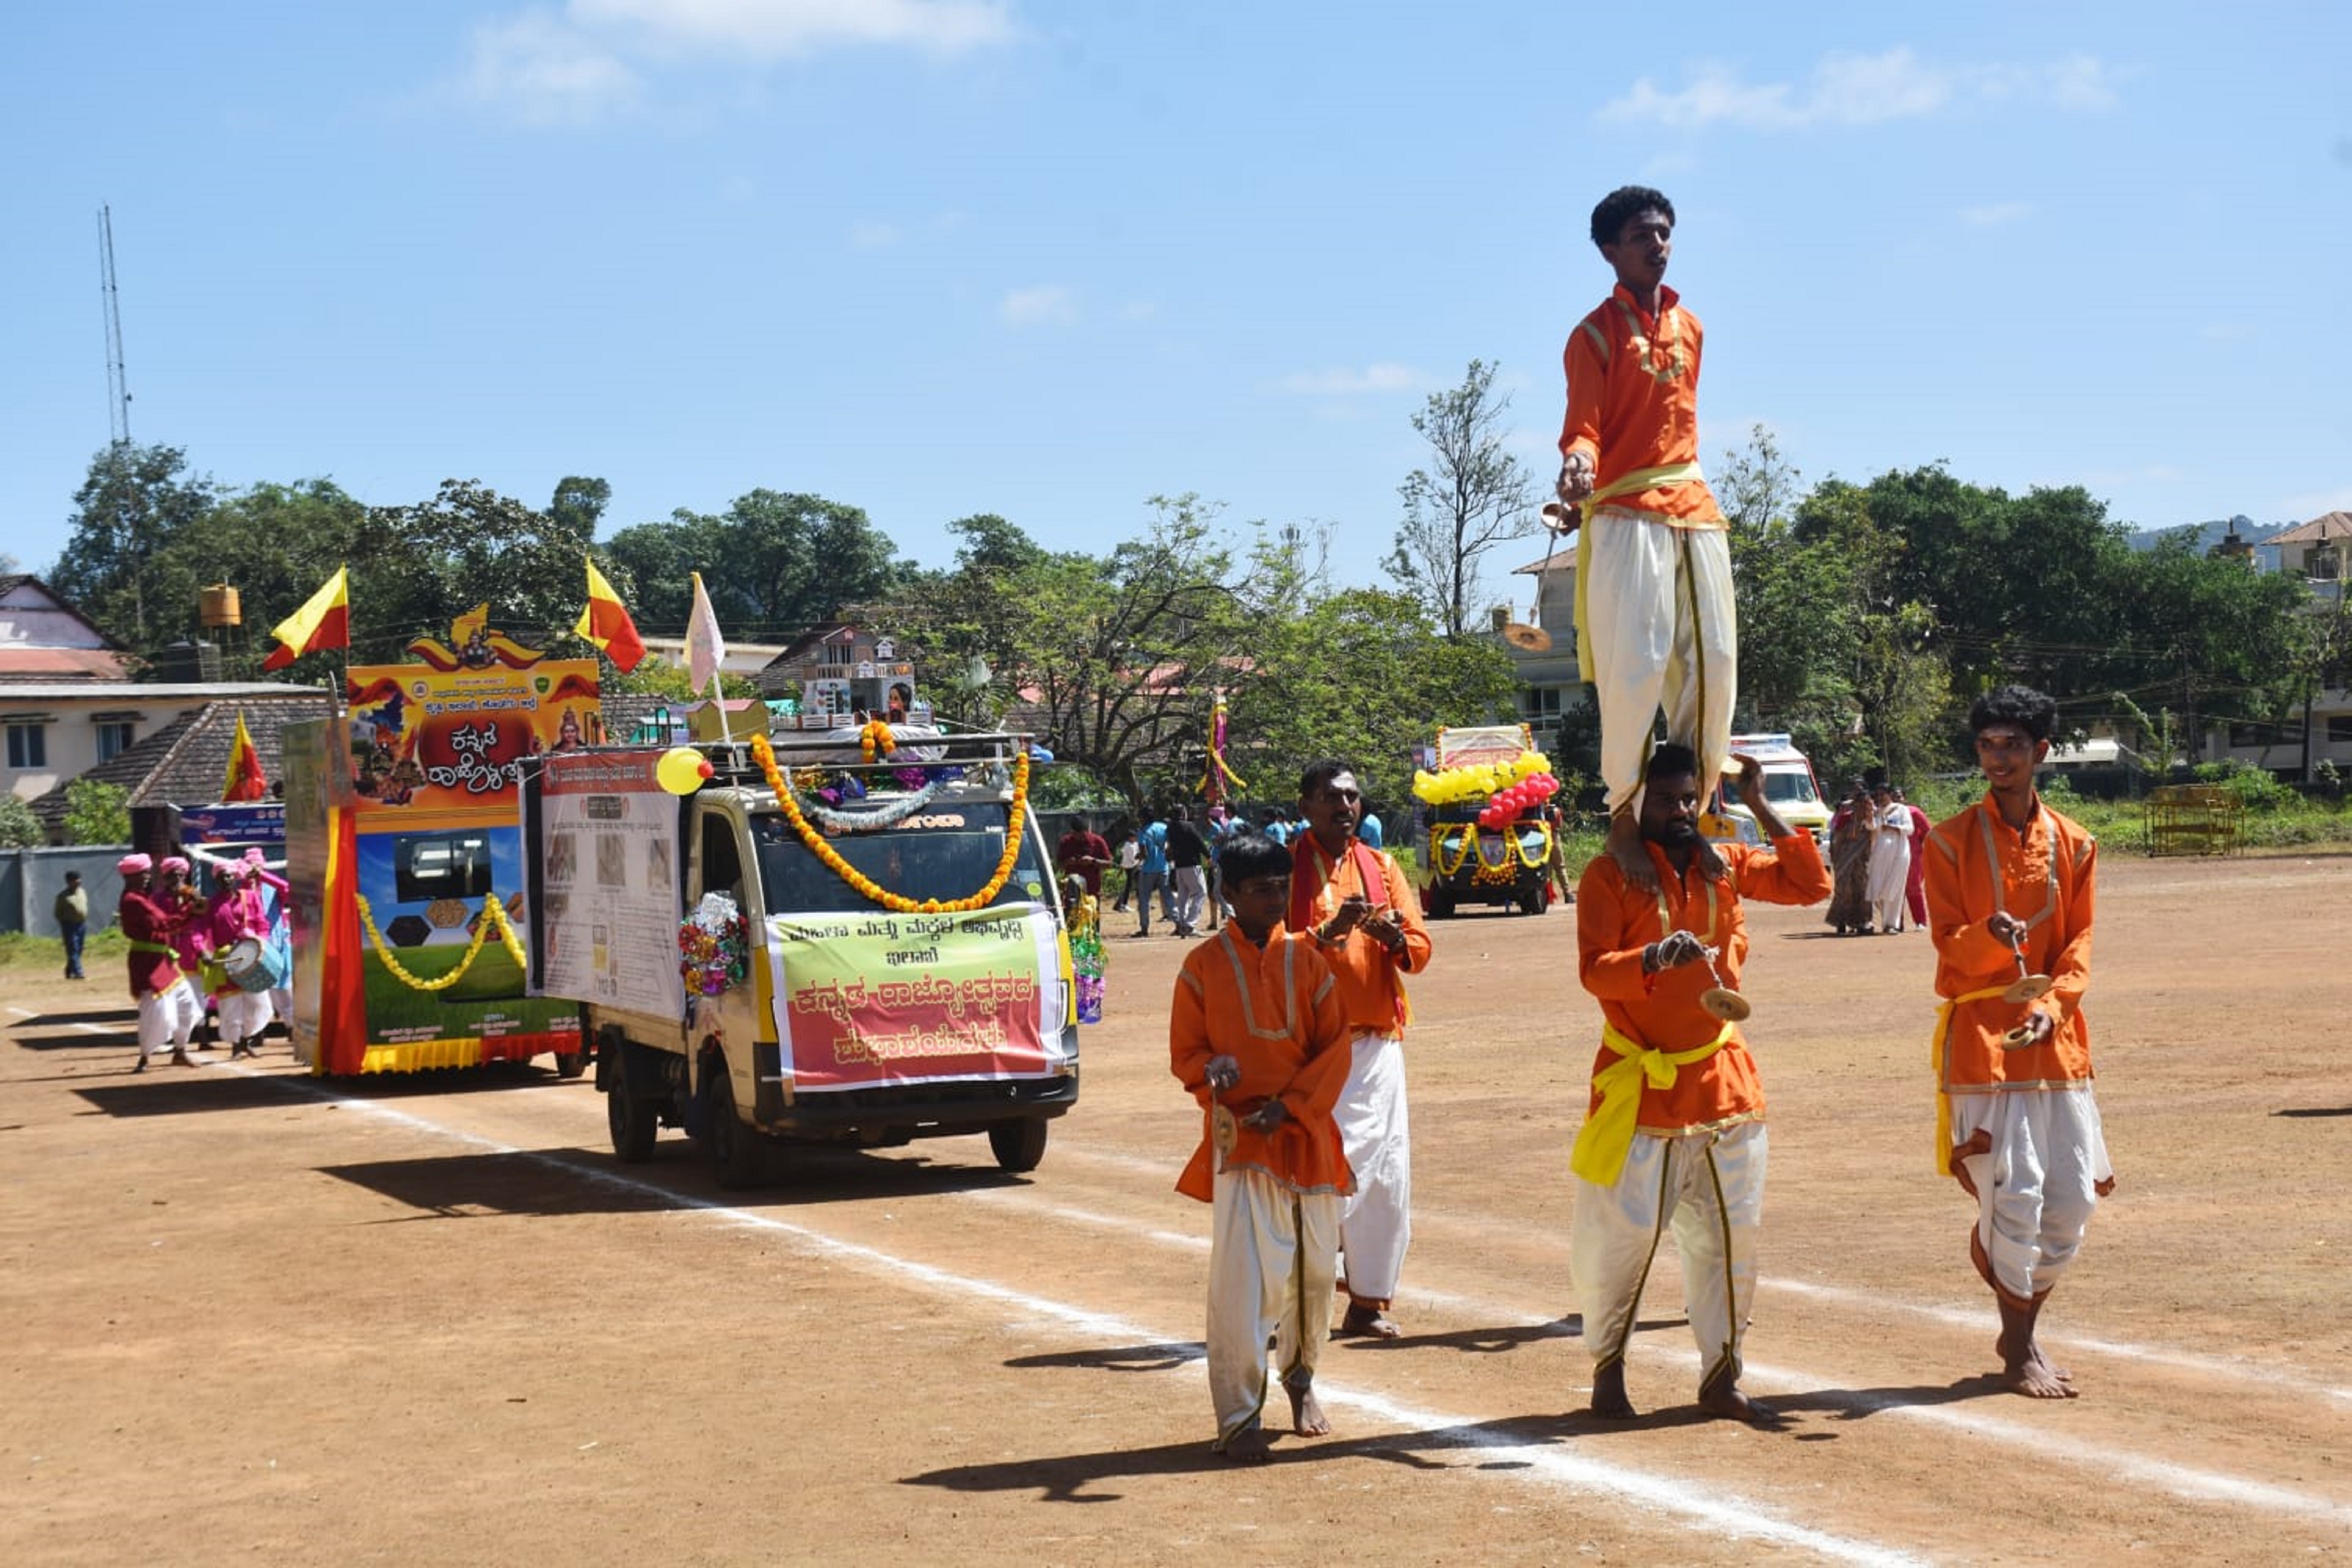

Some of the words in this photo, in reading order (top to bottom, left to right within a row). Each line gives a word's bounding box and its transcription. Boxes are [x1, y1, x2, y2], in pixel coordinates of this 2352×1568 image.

[451, 722, 498, 758] ಕನ್ನಡ
[857, 920, 899, 939] ಮತ್ತು
[906, 917, 953, 941] ಮಕ್ಕಳ
[886, 947, 939, 966] ಇಲಾಖೆ
[795, 971, 868, 1022] ಕನ್ನಡ
[878, 970, 1033, 1018] ರಾಜ್ಯೋತ್ಸವದ
[834, 1020, 1006, 1065] ಶುಭಾಶಯಗಳು
